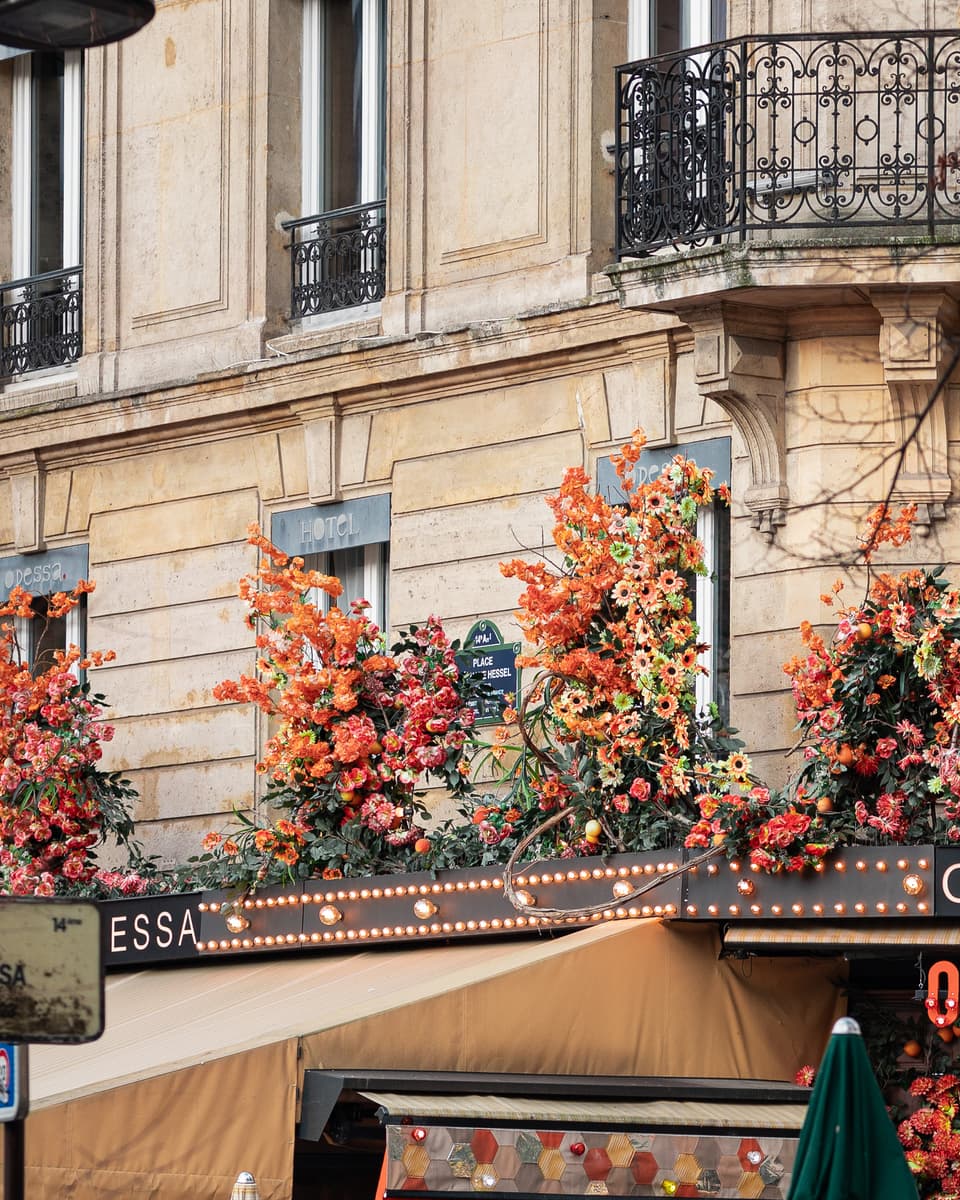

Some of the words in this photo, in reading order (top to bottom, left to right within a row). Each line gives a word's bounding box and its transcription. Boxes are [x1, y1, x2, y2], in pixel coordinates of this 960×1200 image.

[472, 656, 494, 668] PLACE
[487, 668, 512, 680] HESSEL
[110, 908, 198, 953] ESSA
